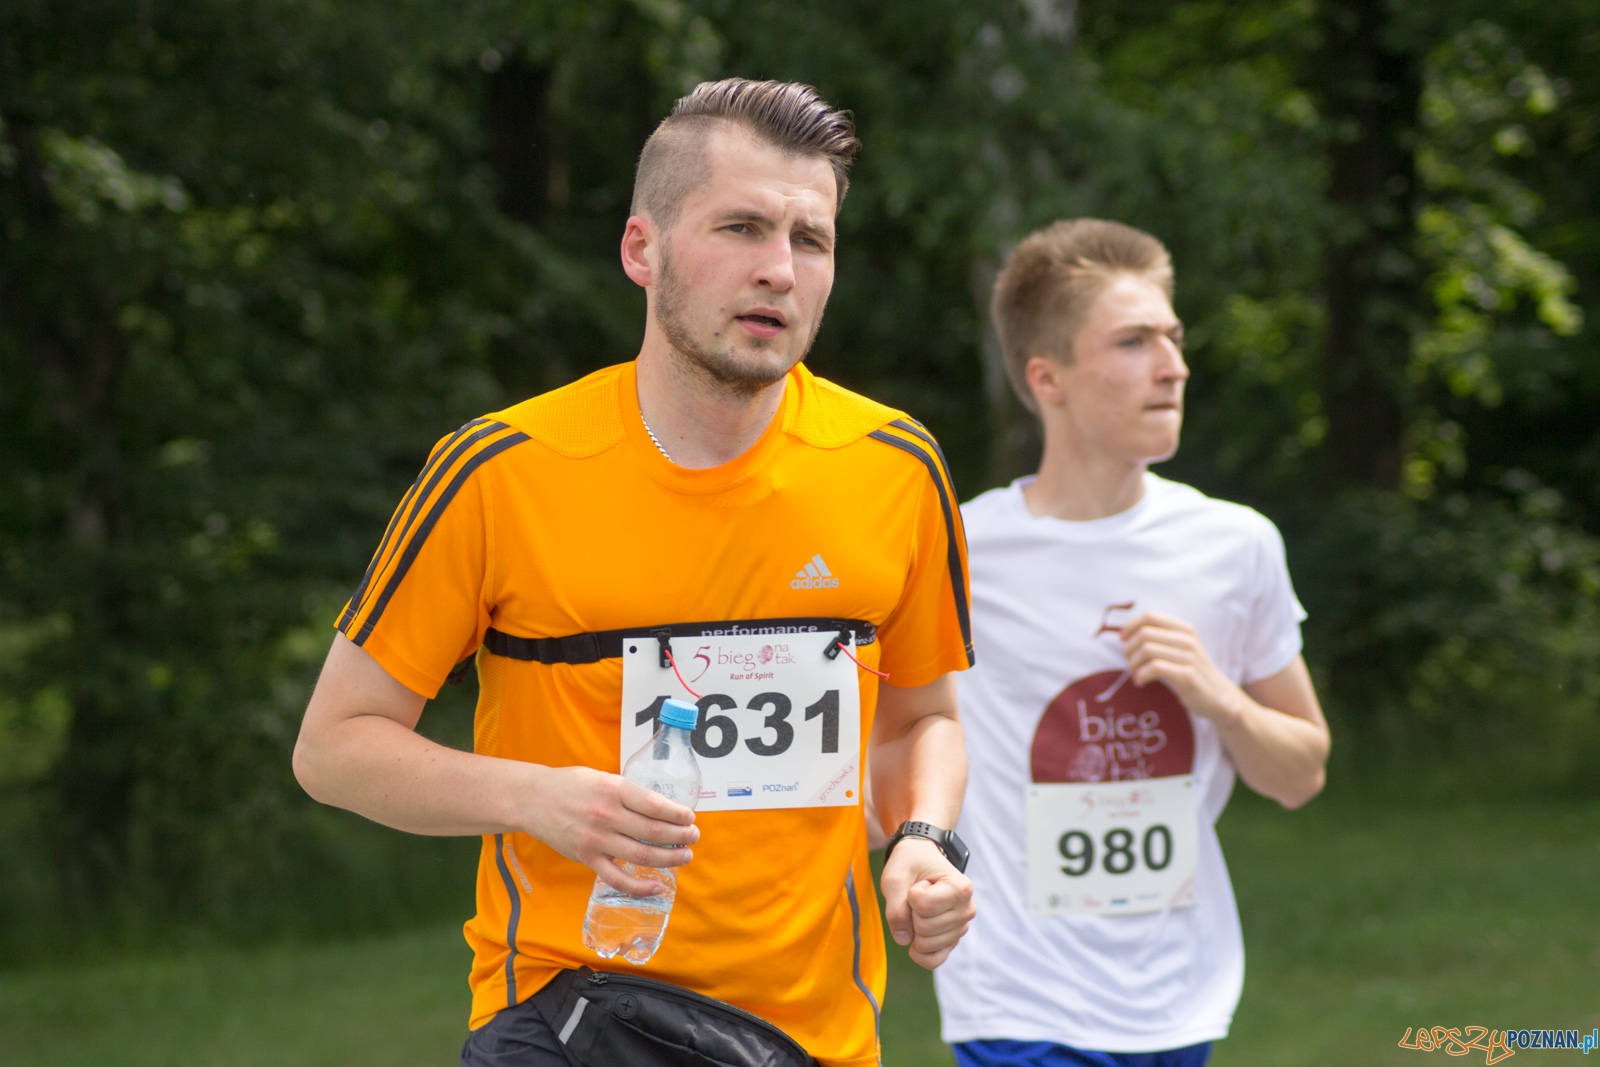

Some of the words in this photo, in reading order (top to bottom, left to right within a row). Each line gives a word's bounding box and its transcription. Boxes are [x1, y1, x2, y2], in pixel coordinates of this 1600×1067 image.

[790, 575, 840, 590] adidas
[701, 625, 818, 637] performance
[717, 647, 756, 672] bieg
[774, 643, 790, 653] na
[775, 652, 797, 664] tak
[690, 645, 712, 683] 5
[745, 672, 754, 680] of
[755, 671, 774, 681] Spirit
[635, 689, 840, 760] 1631
[1077, 699, 1167, 754] bieg
[1105, 739, 1141, 762] na
[1109, 758, 1154, 784] tak
[1057, 823, 1174, 878] 980
